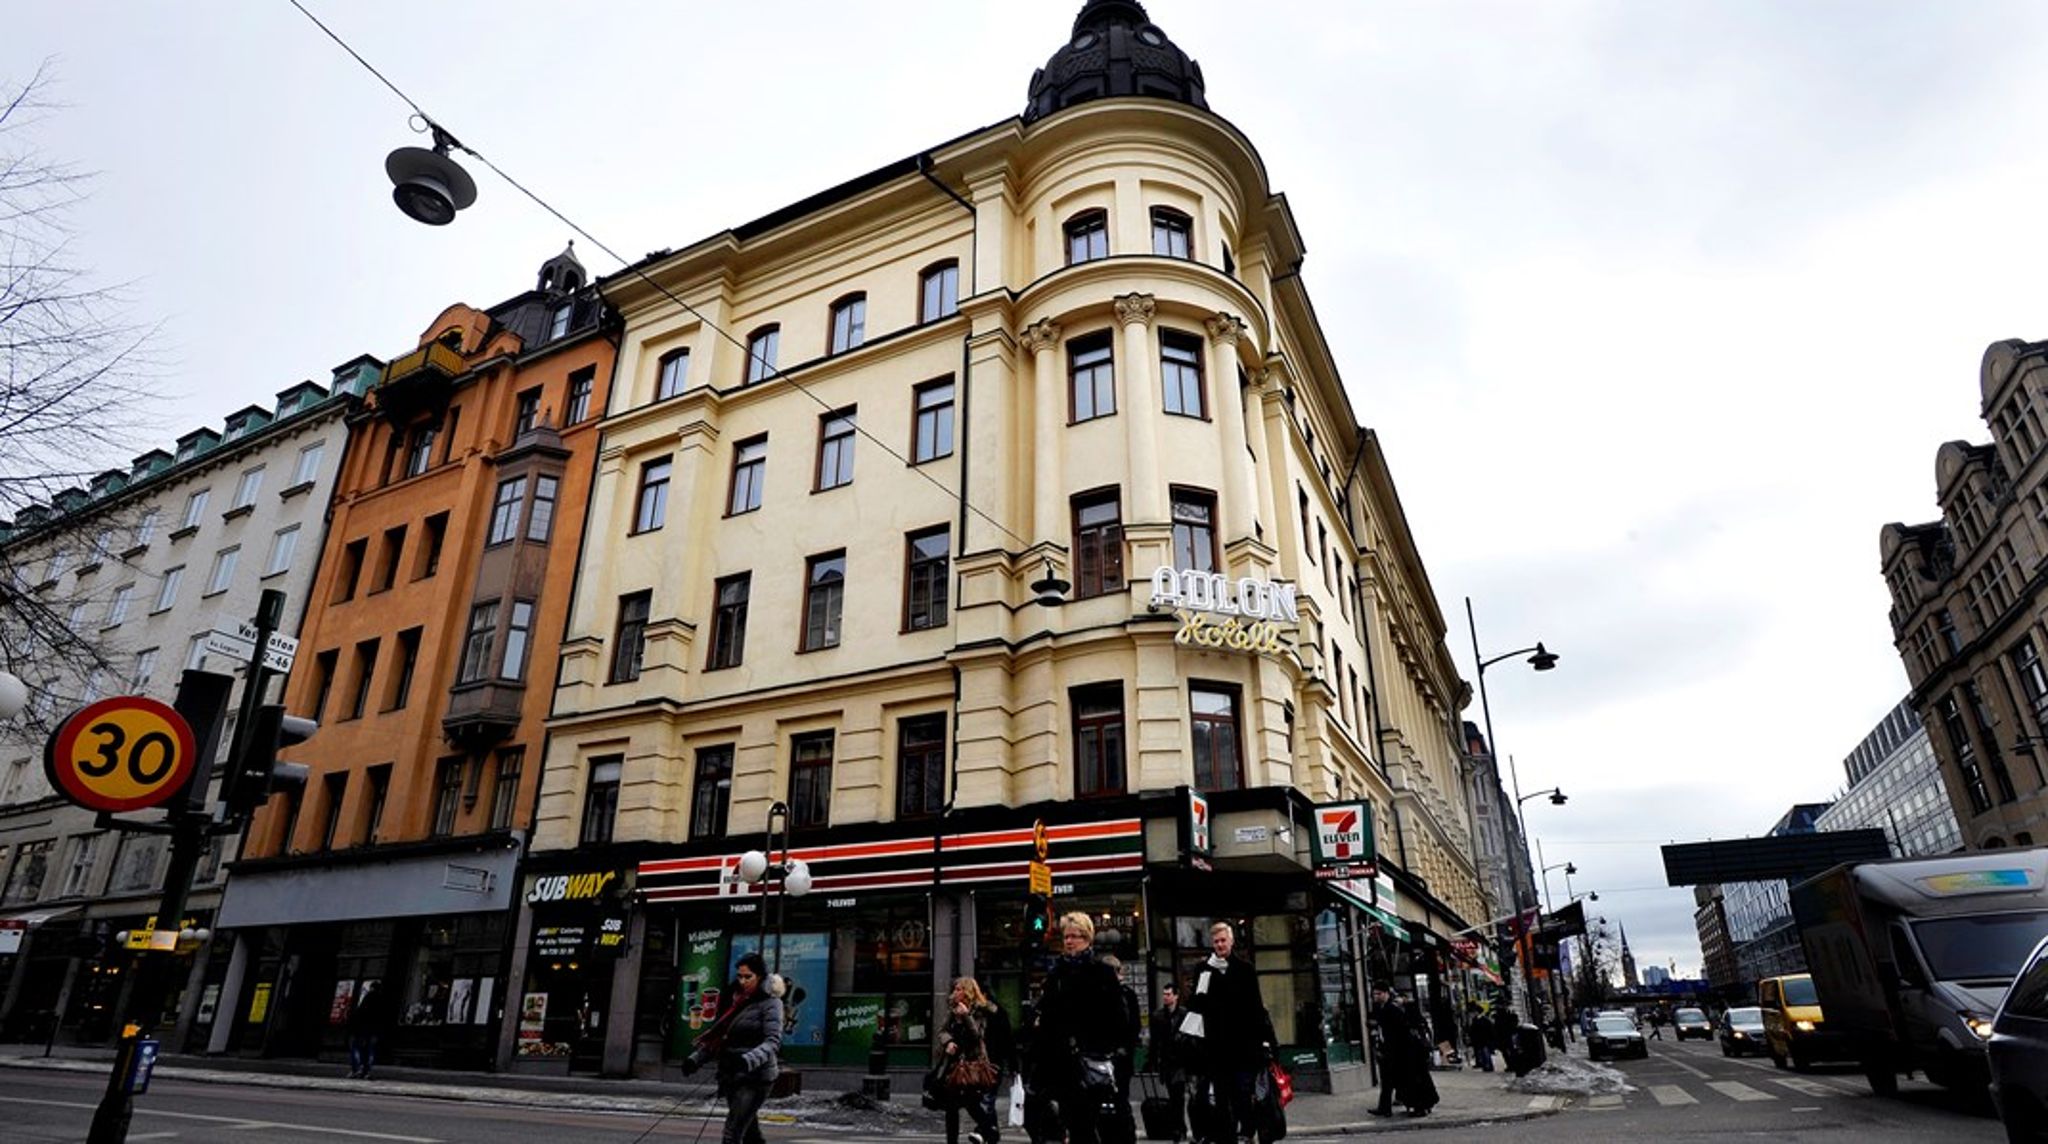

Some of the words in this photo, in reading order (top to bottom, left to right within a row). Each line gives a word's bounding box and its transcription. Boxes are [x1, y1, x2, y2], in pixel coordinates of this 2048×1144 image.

[1151, 565, 1300, 622] ADLON
[1173, 608, 1281, 656] Hotell
[78, 722, 175, 785] 30
[1322, 811, 1357, 857] 7
[1323, 832, 1360, 845] ELEVEN
[527, 870, 616, 902] SUBWAY
